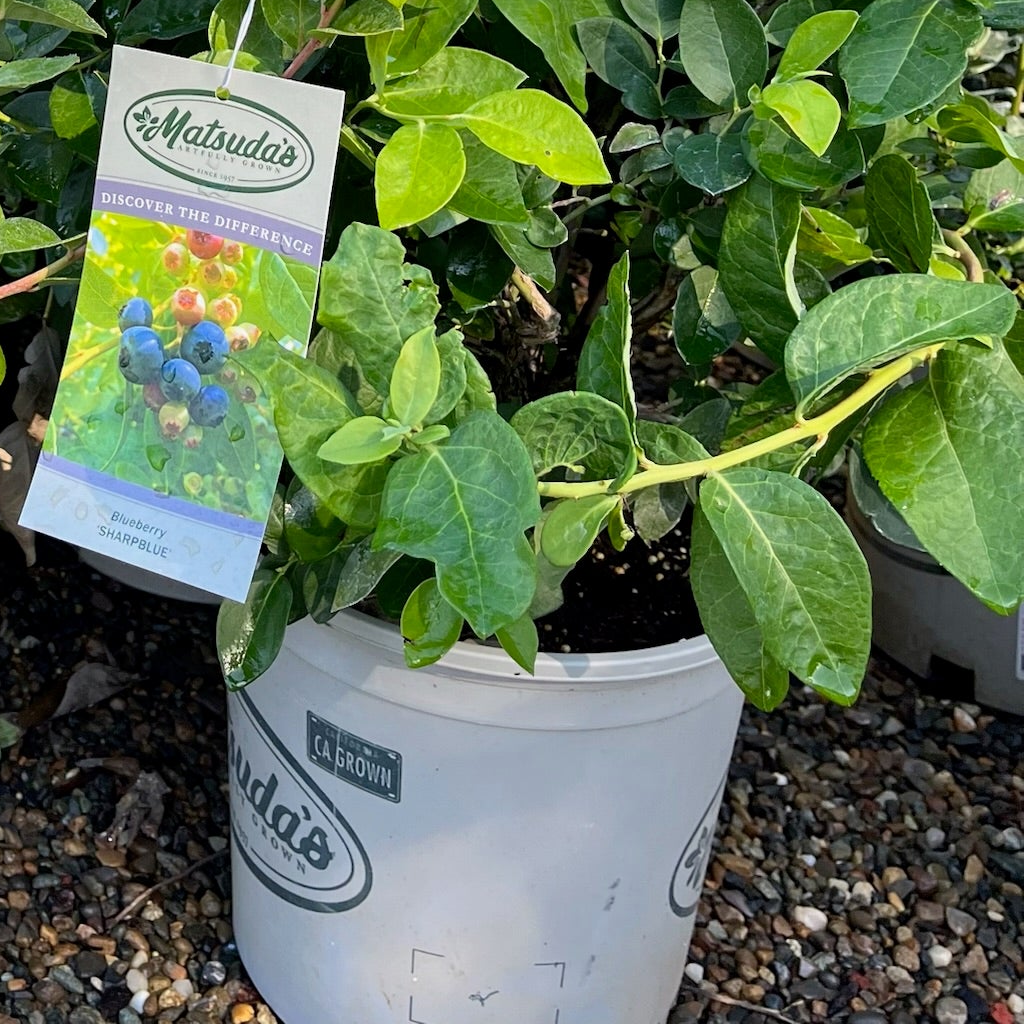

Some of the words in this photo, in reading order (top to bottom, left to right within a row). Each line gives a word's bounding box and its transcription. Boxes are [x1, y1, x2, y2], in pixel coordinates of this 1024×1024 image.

[142, 106, 298, 167] Matsuda's
[177, 144, 236, 164] ARTFULLY
[242, 159, 281, 174] GROWN
[196, 168, 218, 179] SINCE
[101, 192, 174, 216] DISCOVER
[178, 206, 210, 224] THE
[214, 214, 313, 256] DIFFERENCE
[110, 510, 168, 540] Blueberry
[314, 734, 334, 762] CA
[336, 747, 392, 789] GROWN
